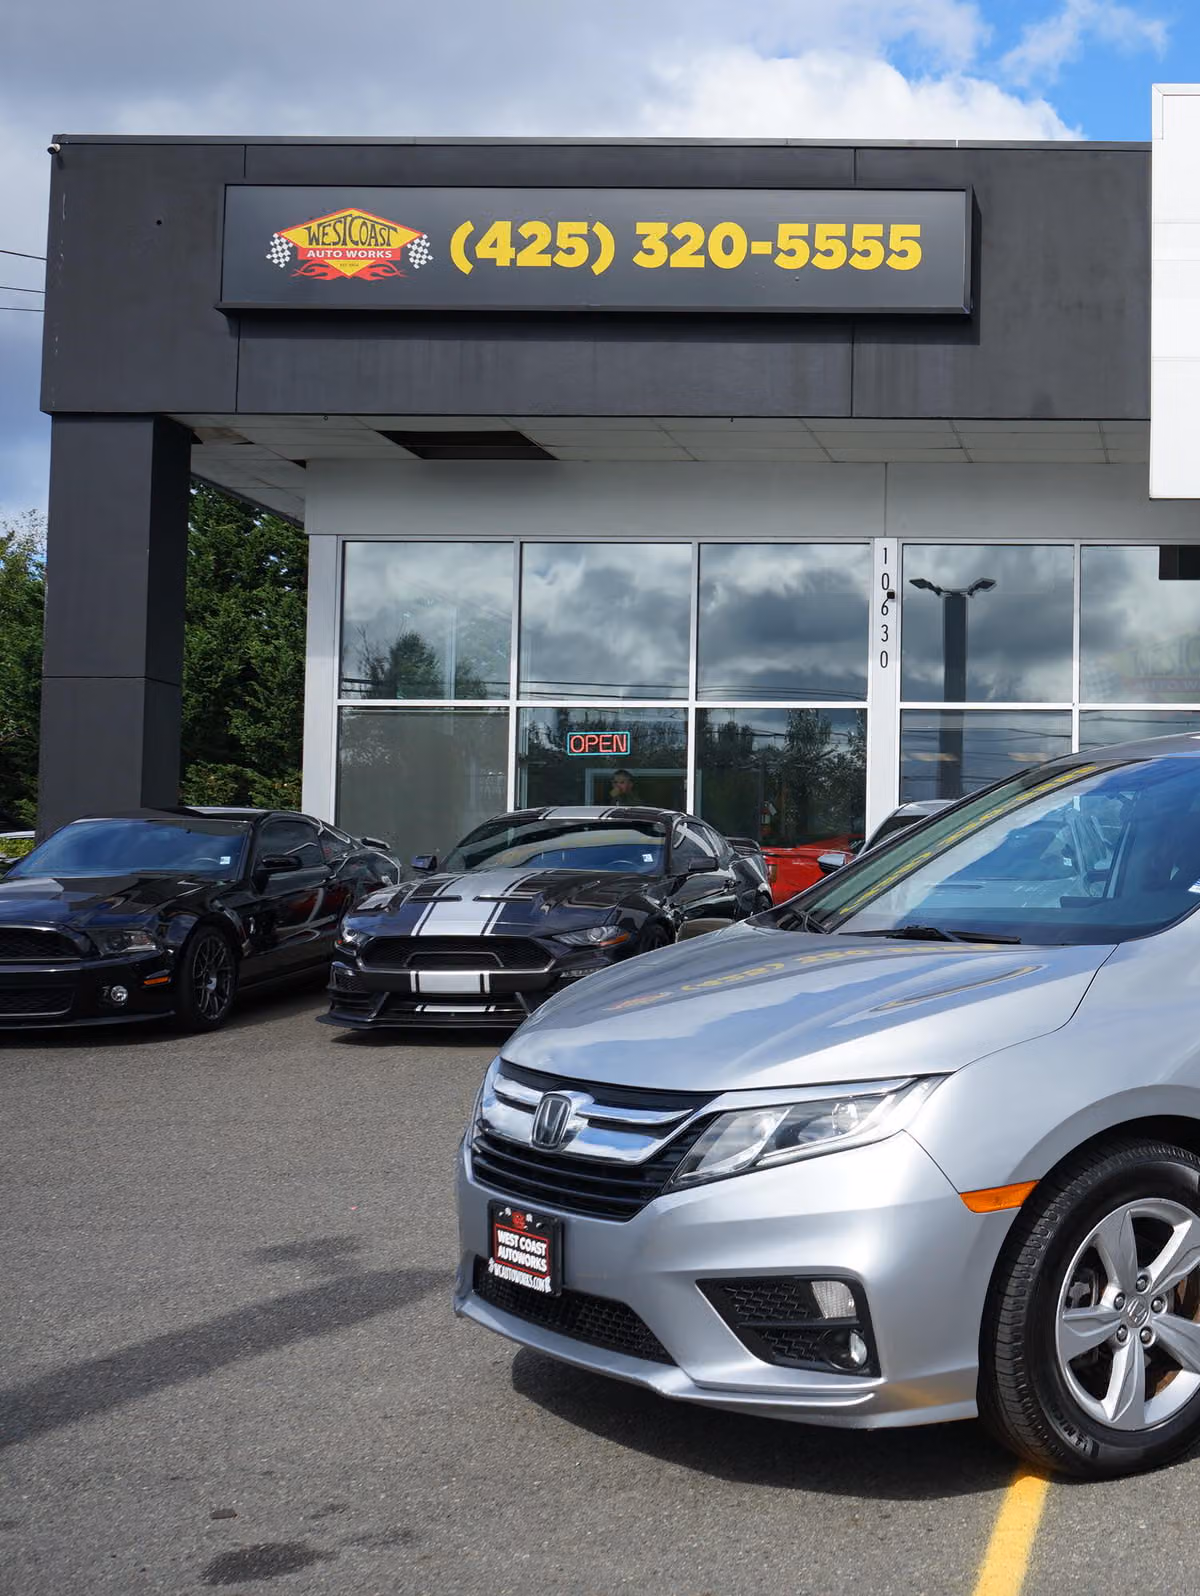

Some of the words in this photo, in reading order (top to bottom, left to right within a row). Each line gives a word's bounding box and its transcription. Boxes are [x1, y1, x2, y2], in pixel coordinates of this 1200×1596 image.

[306, 250, 342, 258] AUTO
[343, 250, 393, 258] WORKS
[451, 221, 614, 275] (425)
[632, 222, 922, 270] 320-5555
[880, 547, 890, 669] 10630
[570, 734, 627, 753] OPEN
[497, 1230, 519, 1248] WEST
[520, 1237, 548, 1256] COAST
[498, 1245, 548, 1272] AUTOWORKS
